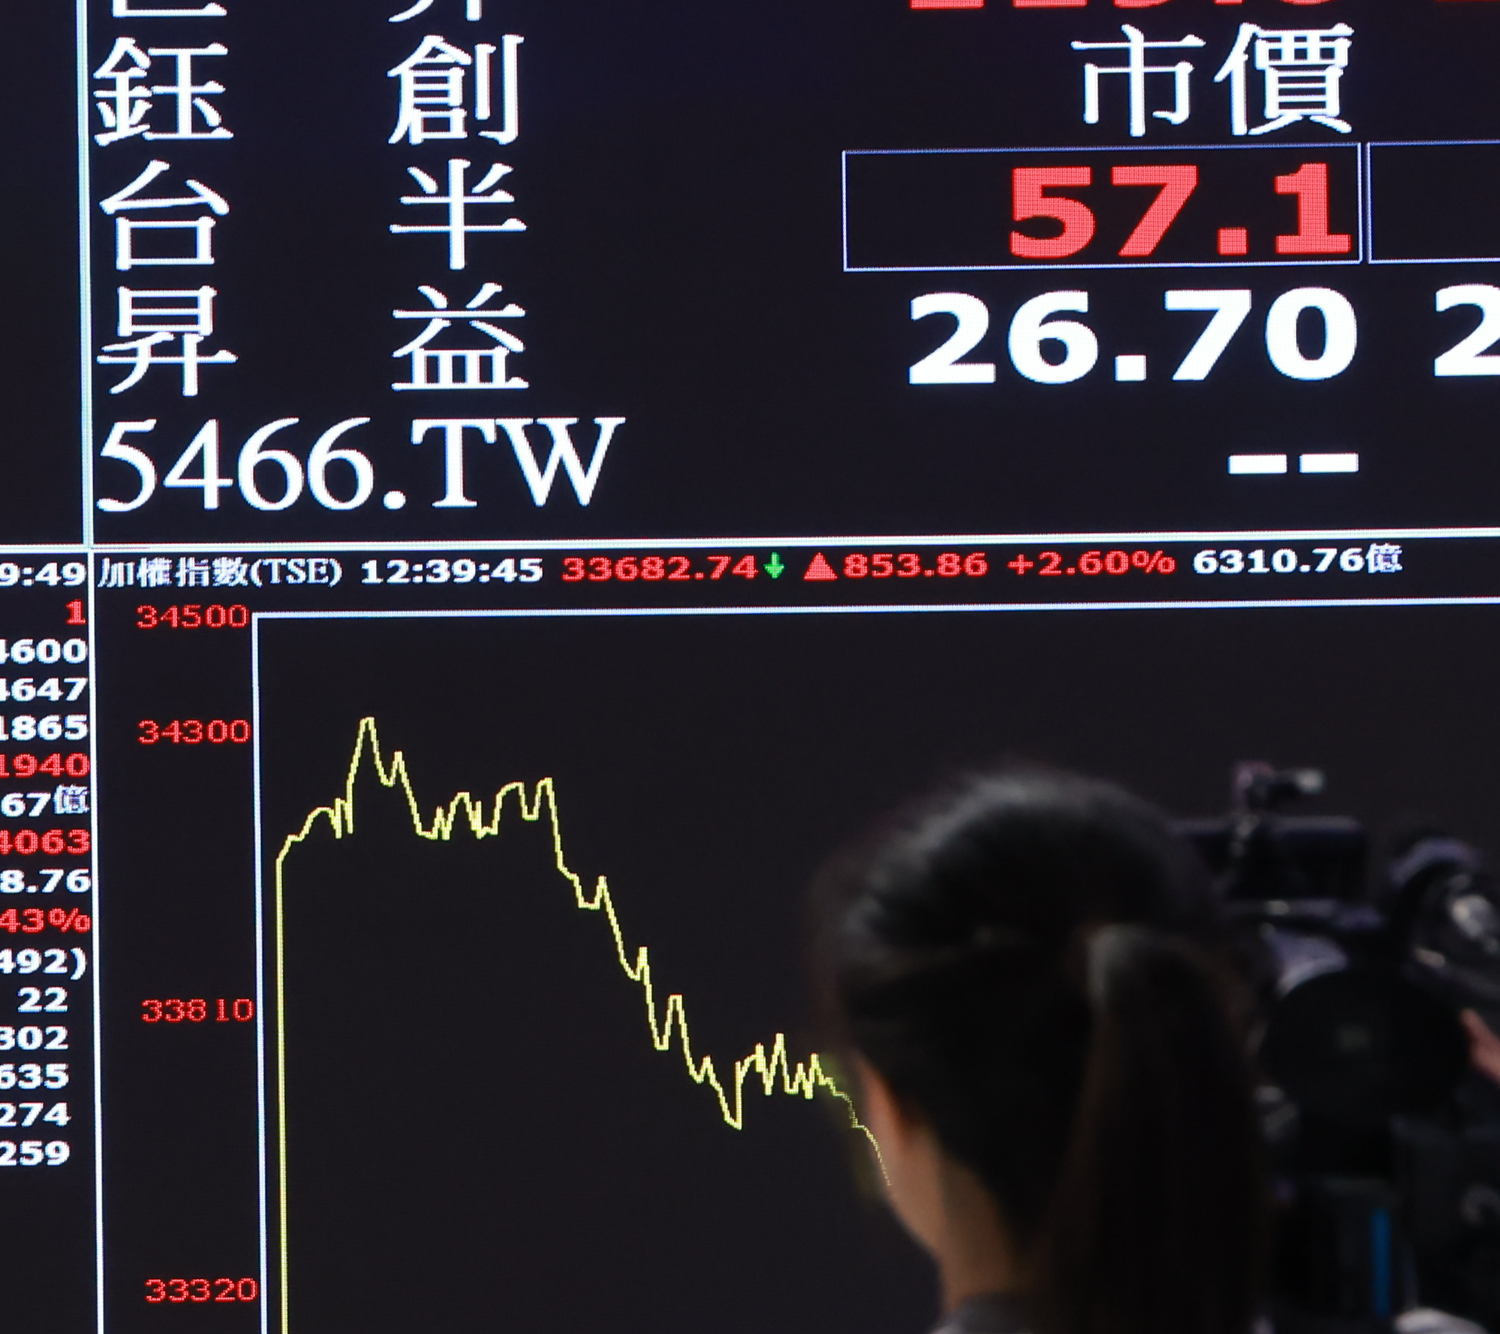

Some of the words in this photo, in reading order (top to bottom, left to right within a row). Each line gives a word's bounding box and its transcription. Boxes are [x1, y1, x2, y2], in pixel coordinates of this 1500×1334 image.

[1070, 22, 1356, 137] 市價
[910, 288, 1356, 383] 26.70
[96, 415, 626, 513] 5466.TW
[362, 559, 542, 583] 12:39:45
[562, 555, 759, 582] 33682.74
[843, 552, 988, 578] 853.86
[1007, 550, 1176, 576] +2.60%
[137, 604, 249, 628] 34500
[138, 720, 251, 744] 34300
[18, 987, 67, 1012] 22
[142, 999, 254, 1022] 33810
[145, 1278, 258, 1303] 33320
